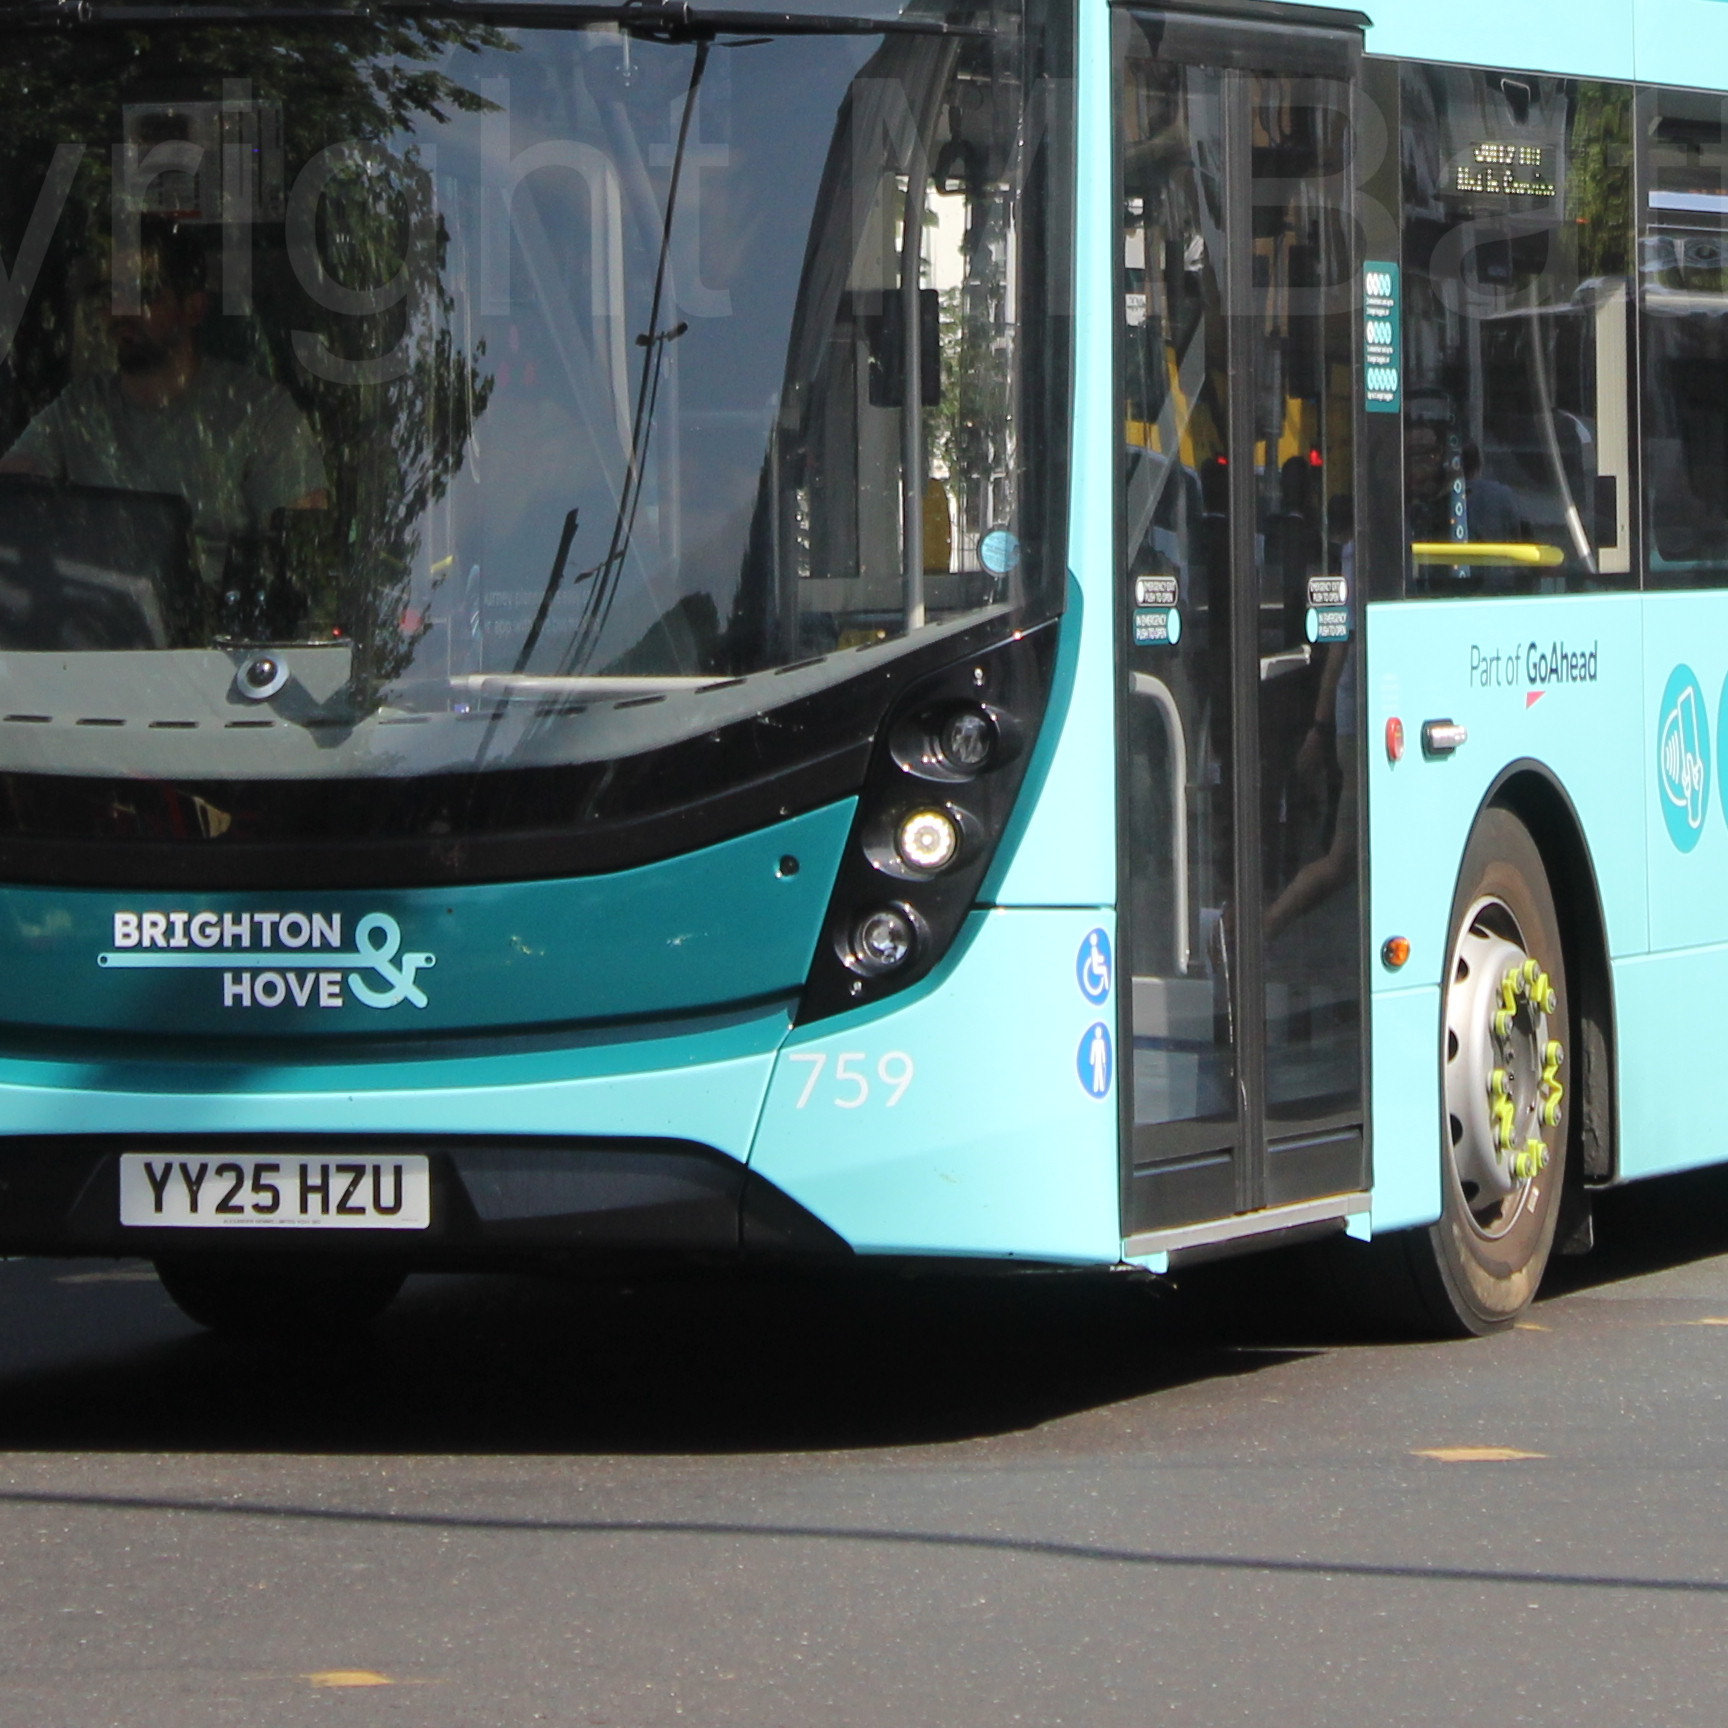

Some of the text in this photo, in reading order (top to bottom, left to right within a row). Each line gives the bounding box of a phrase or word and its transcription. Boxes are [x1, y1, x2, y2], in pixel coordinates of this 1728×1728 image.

[1470, 639, 1598, 688] Part of GoAhead
[113, 911, 342, 949] BRIGHTON
[223, 971, 344, 1008] HOVE
[788, 1049, 915, 1110] 759
[143, 1162, 404, 1216] YY25 HZU
